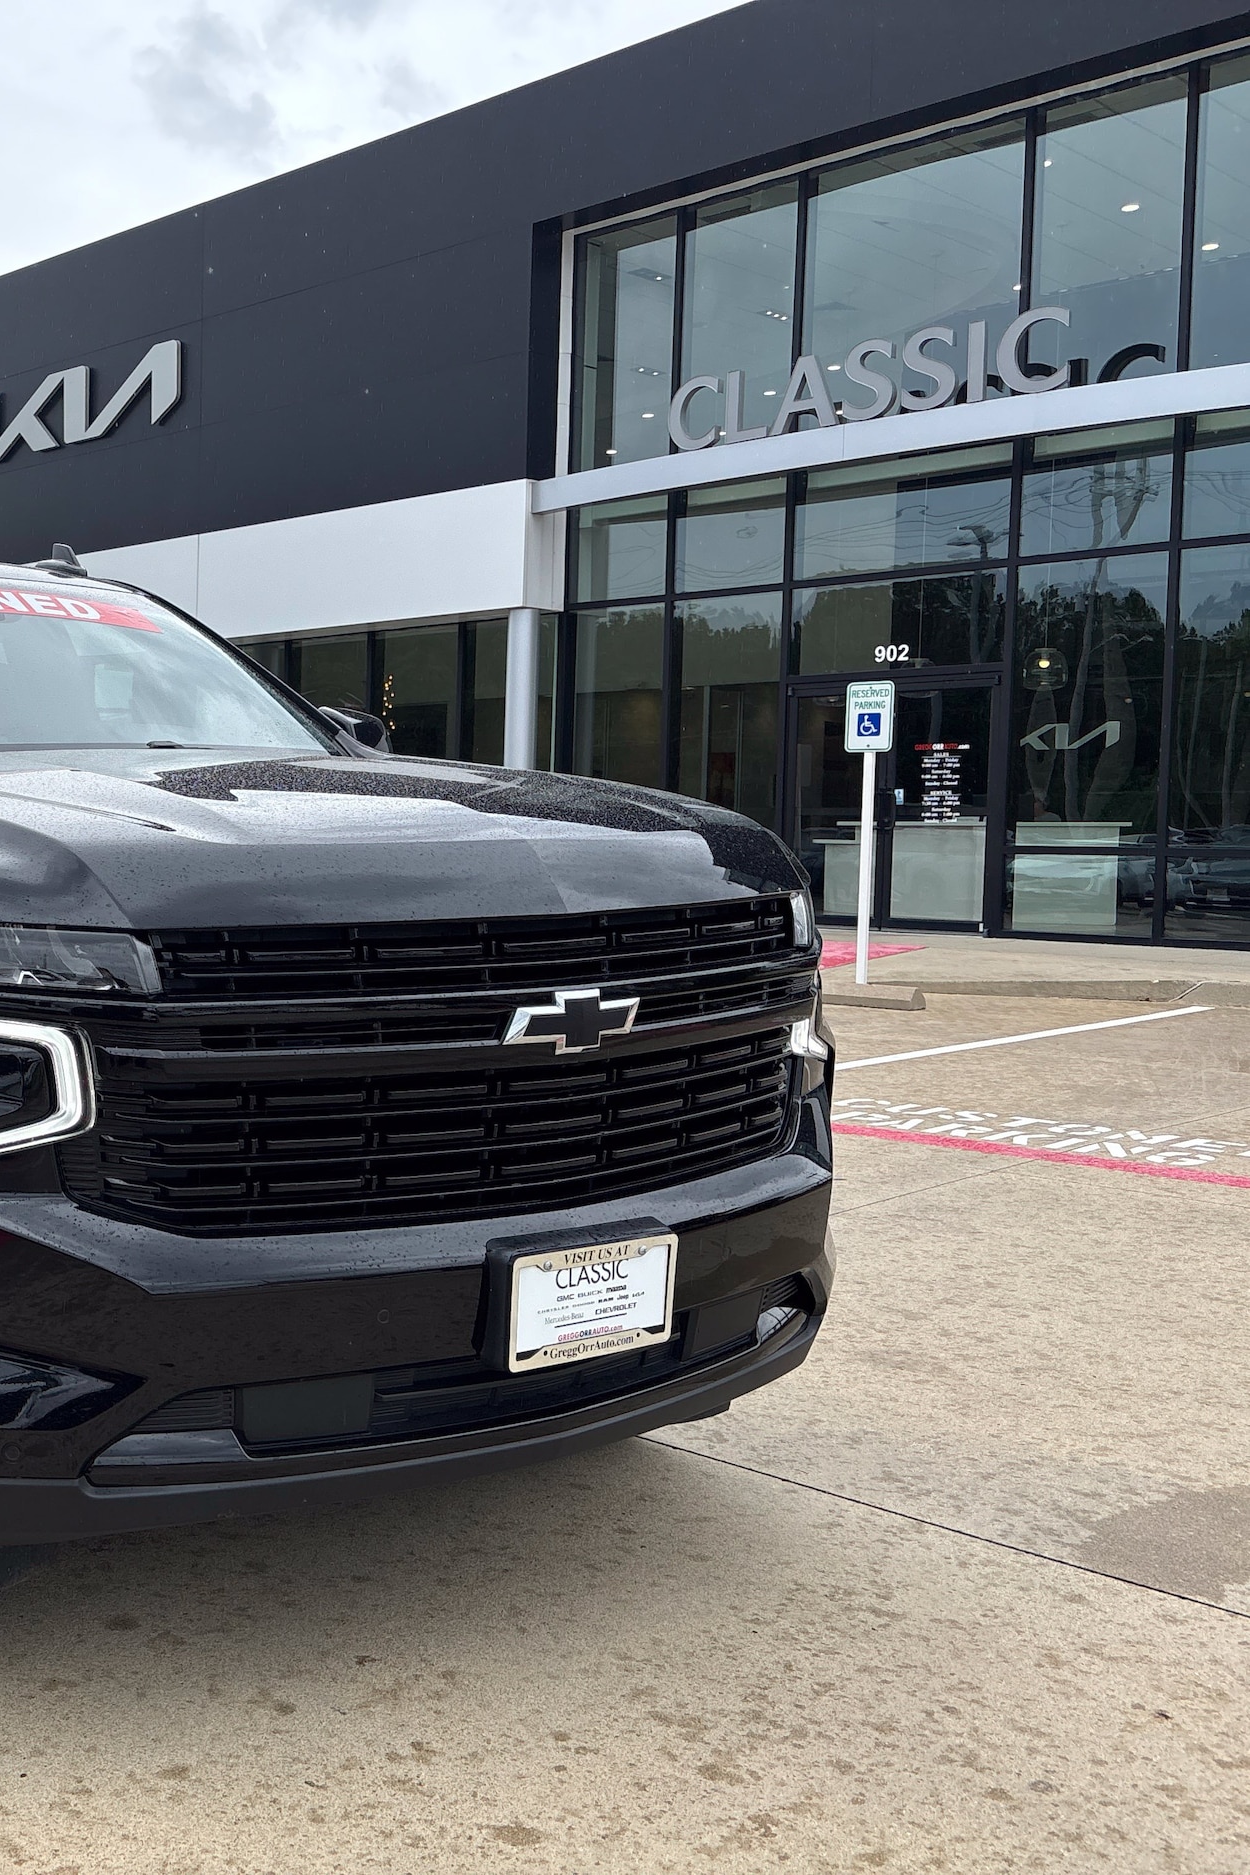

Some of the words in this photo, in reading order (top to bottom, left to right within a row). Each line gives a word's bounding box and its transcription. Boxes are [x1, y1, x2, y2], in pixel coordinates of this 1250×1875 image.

[668, 306, 1071, 451] CLASSIC
[874, 644, 910, 663] 902
[851, 688, 890, 699] RESERVED
[854, 700, 886, 710] PARKING
[834, 1098, 1250, 1157] CUSTOME
[831, 1111, 1216, 1166] PARKING
[564, 1250, 595, 1265] VISIT
[598, 1248, 613, 1260] US
[615, 1245, 630, 1257] AT
[555, 1259, 629, 1289] CLASSIC
[556, 1294, 575, 1302] GMC
[577, 1288, 603, 1298] BUICK
[616, 1293, 629, 1301] Jeep
[595, 1302, 638, 1315] CHEVROLET
[557, 1324, 623, 1342] GREGGORRAUTO.com
[549, 1335, 634, 1359] GreggOrrAuto.com
